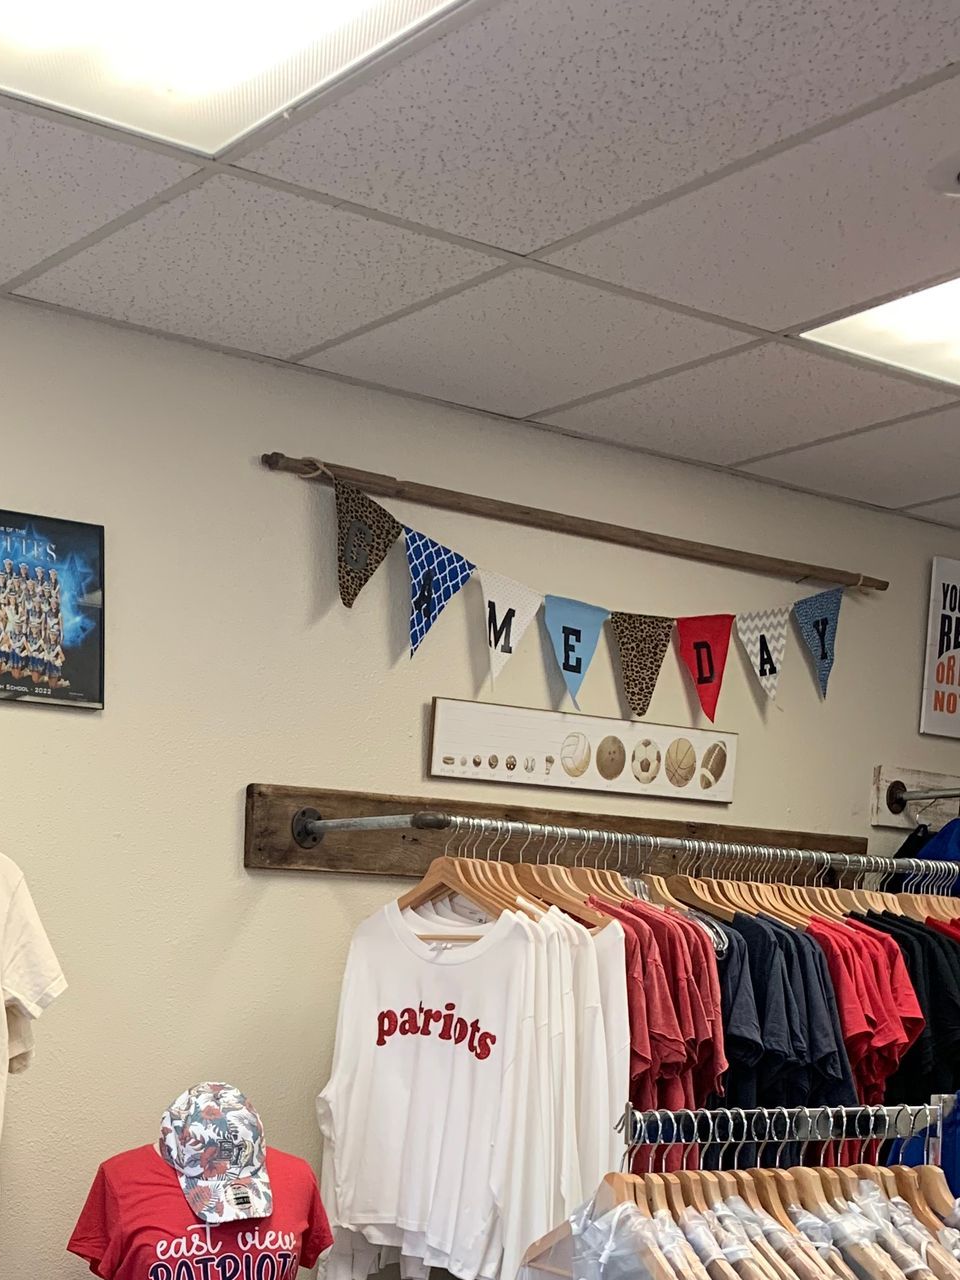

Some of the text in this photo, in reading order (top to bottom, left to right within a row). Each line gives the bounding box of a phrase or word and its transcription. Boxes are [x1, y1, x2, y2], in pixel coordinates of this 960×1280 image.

[941, 582, 960, 613] YO
[693, 617, 829, 685] DAY
[156, 1222, 297, 1260] east view
